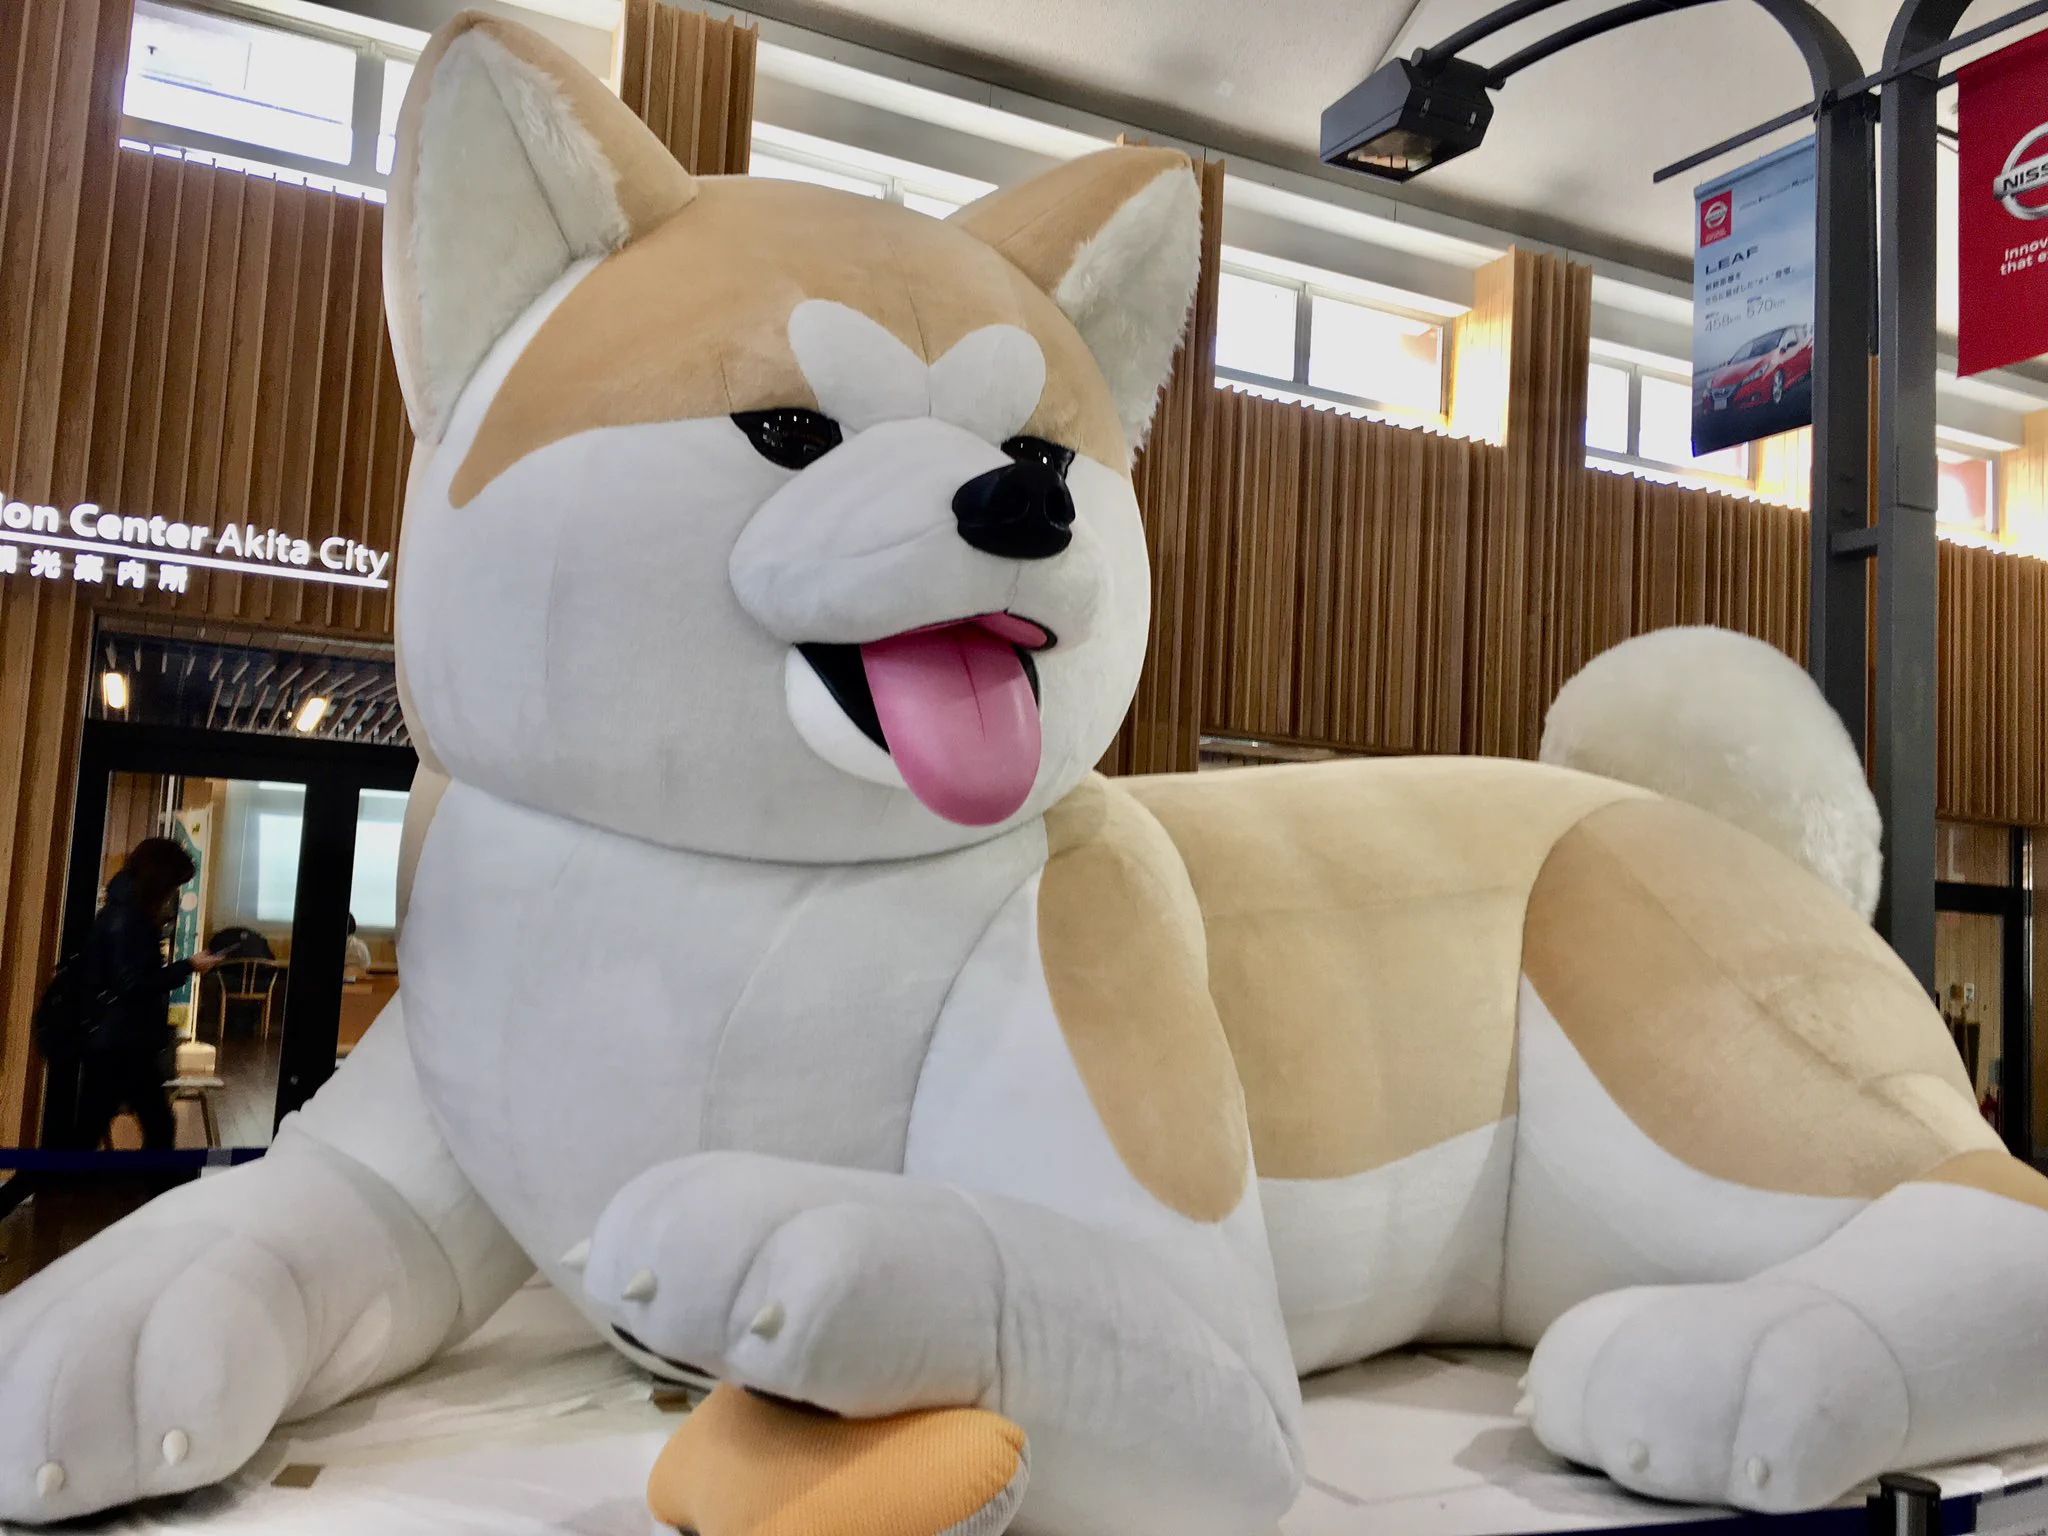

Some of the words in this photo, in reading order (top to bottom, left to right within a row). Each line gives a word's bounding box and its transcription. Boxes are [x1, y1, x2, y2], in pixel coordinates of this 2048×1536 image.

[1705, 245, 1759, 275] LEAF
[2000, 254, 2033, 276] that
[69, 503, 209, 551] Center
[215, 523, 310, 565] Akita
[319, 536, 389, 580] City
